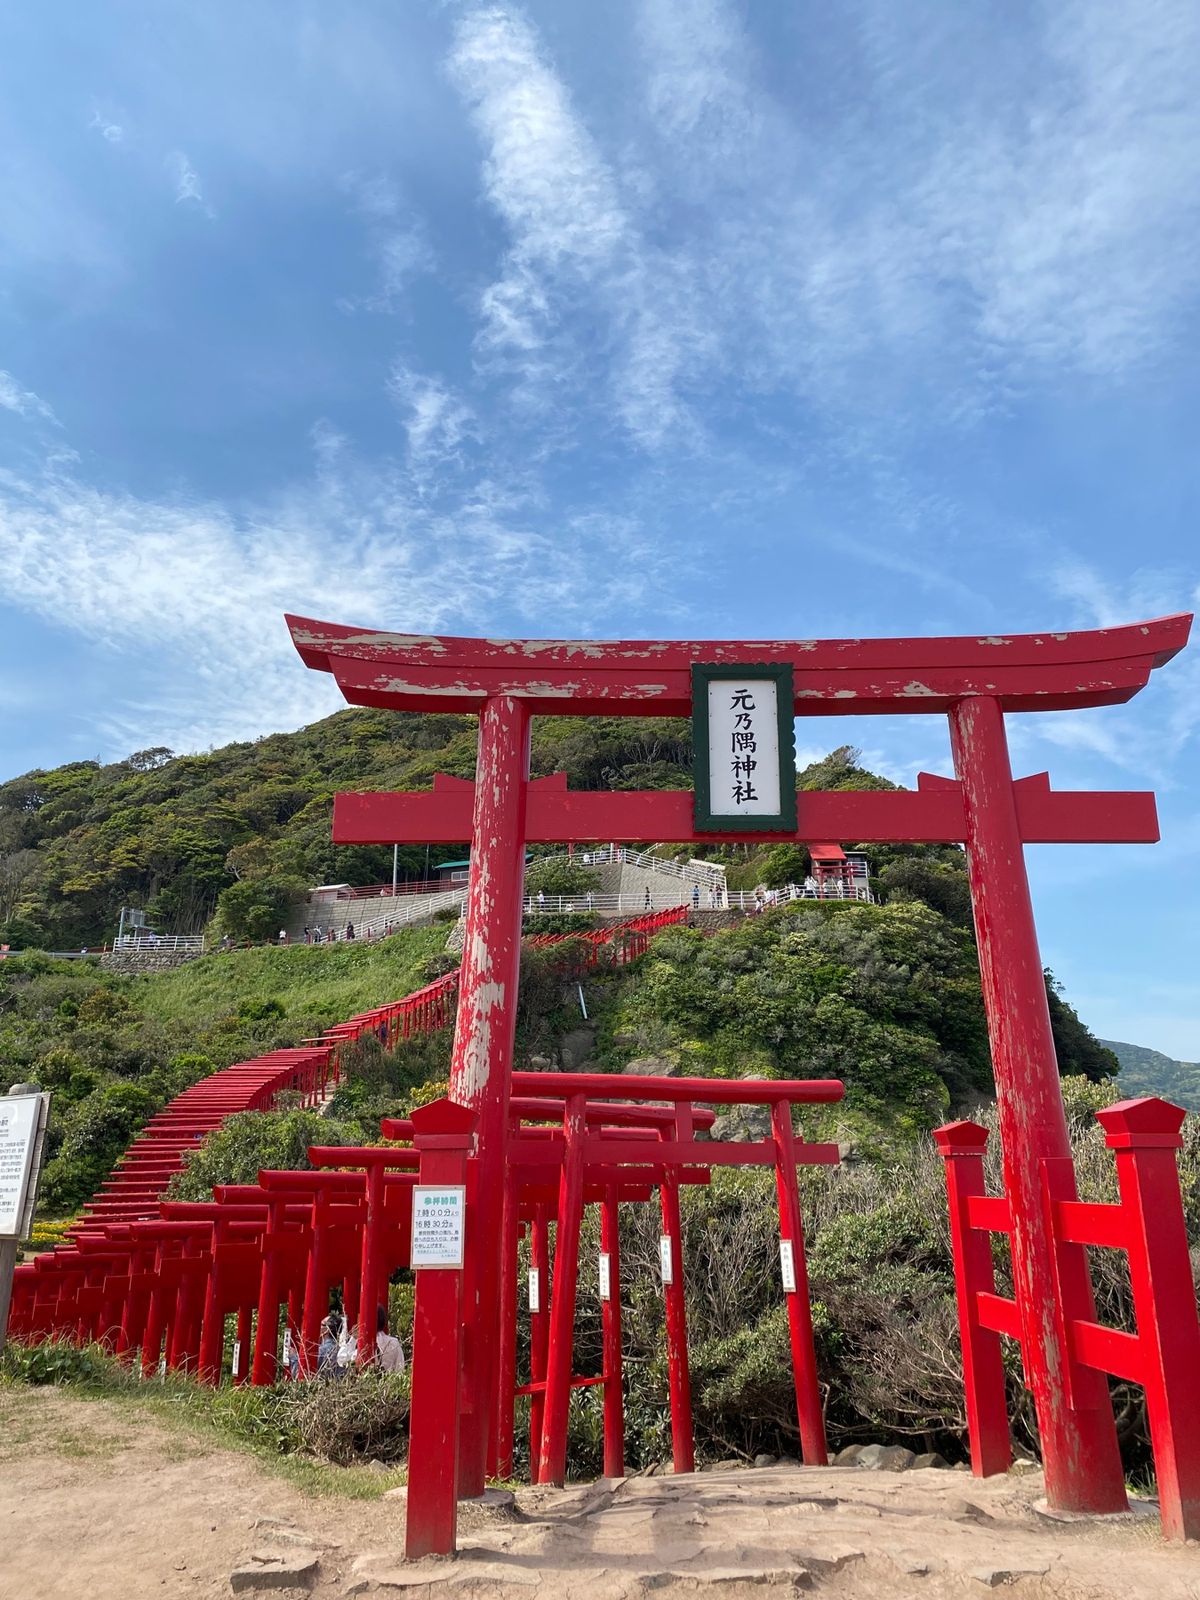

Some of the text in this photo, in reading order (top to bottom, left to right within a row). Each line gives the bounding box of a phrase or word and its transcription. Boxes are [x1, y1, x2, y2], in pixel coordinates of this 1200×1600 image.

[729, 689, 759, 805] 元乃隅神社
[424, 1196, 457, 1206] 参拝時間
